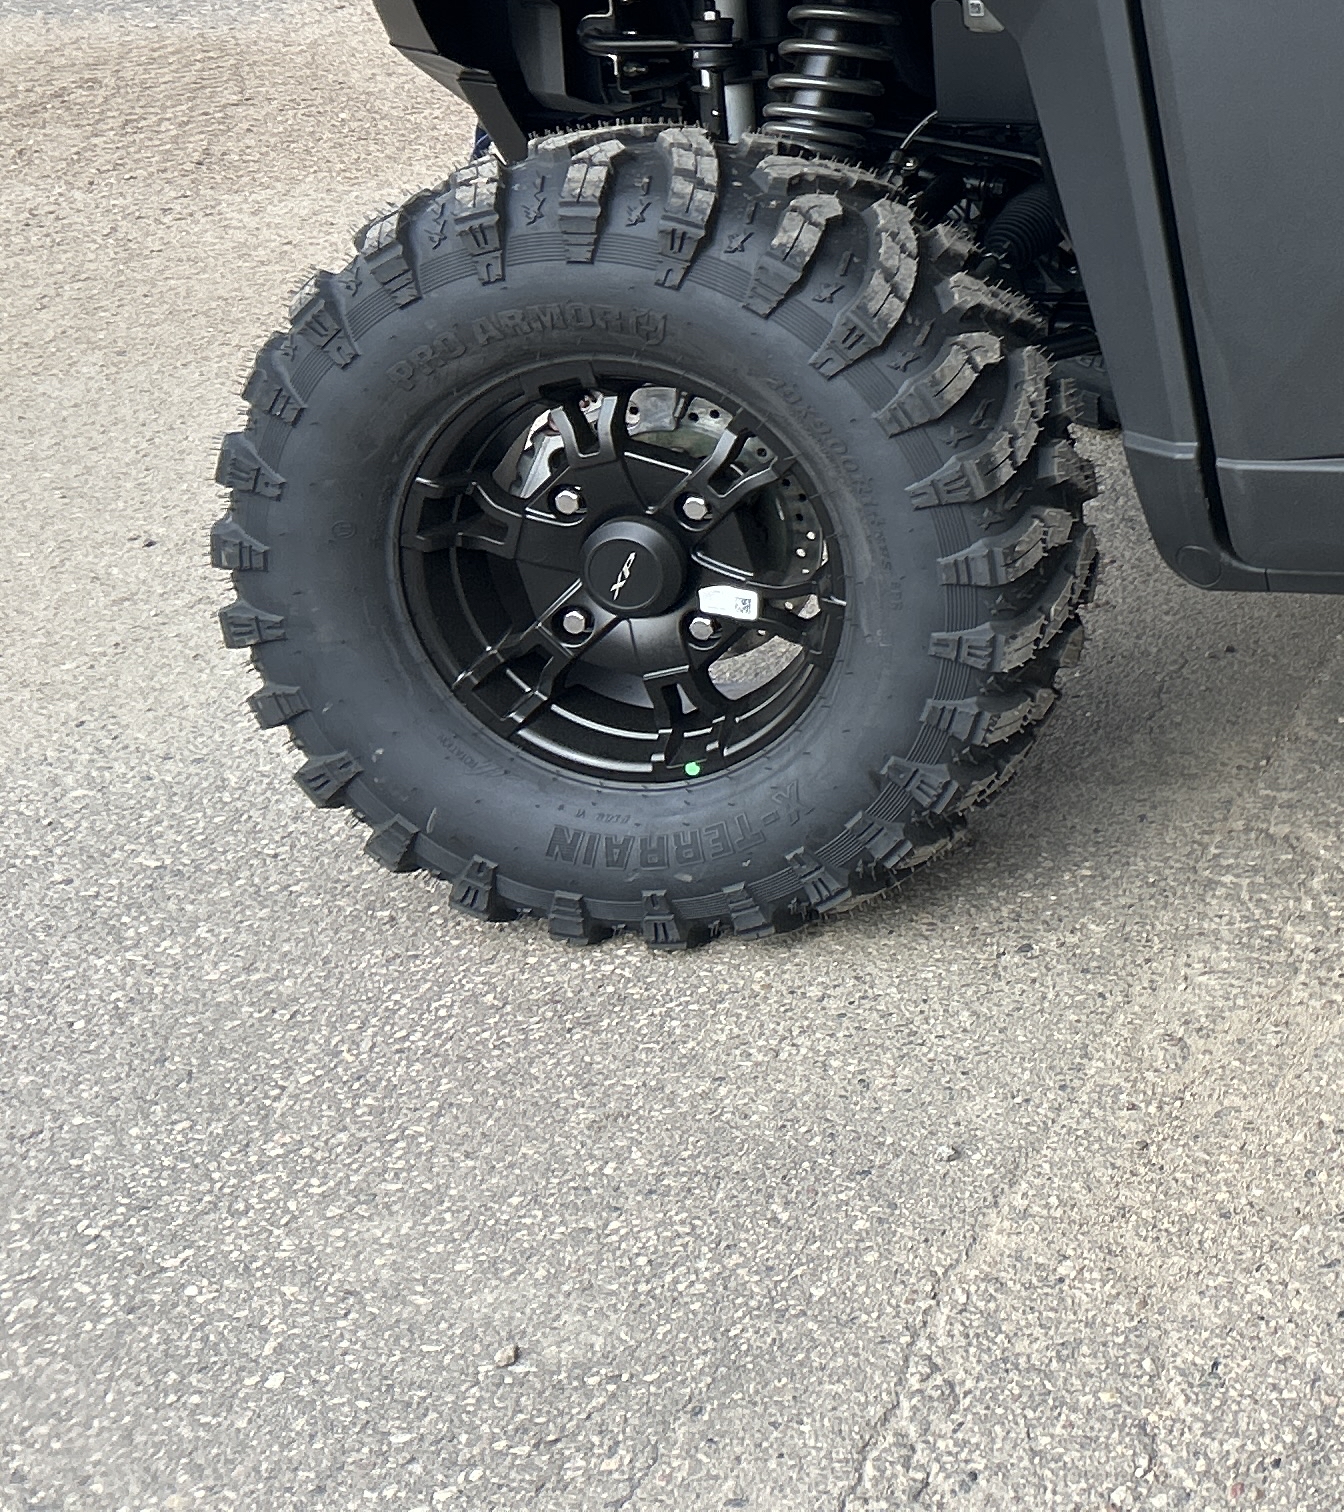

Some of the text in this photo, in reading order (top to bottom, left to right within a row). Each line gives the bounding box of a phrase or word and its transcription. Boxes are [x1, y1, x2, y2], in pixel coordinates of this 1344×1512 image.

[386, 302, 633, 391] PRO ARMOR
[609, 551, 637, 601] XP
[545, 782, 805, 871] X-TERRAIN
